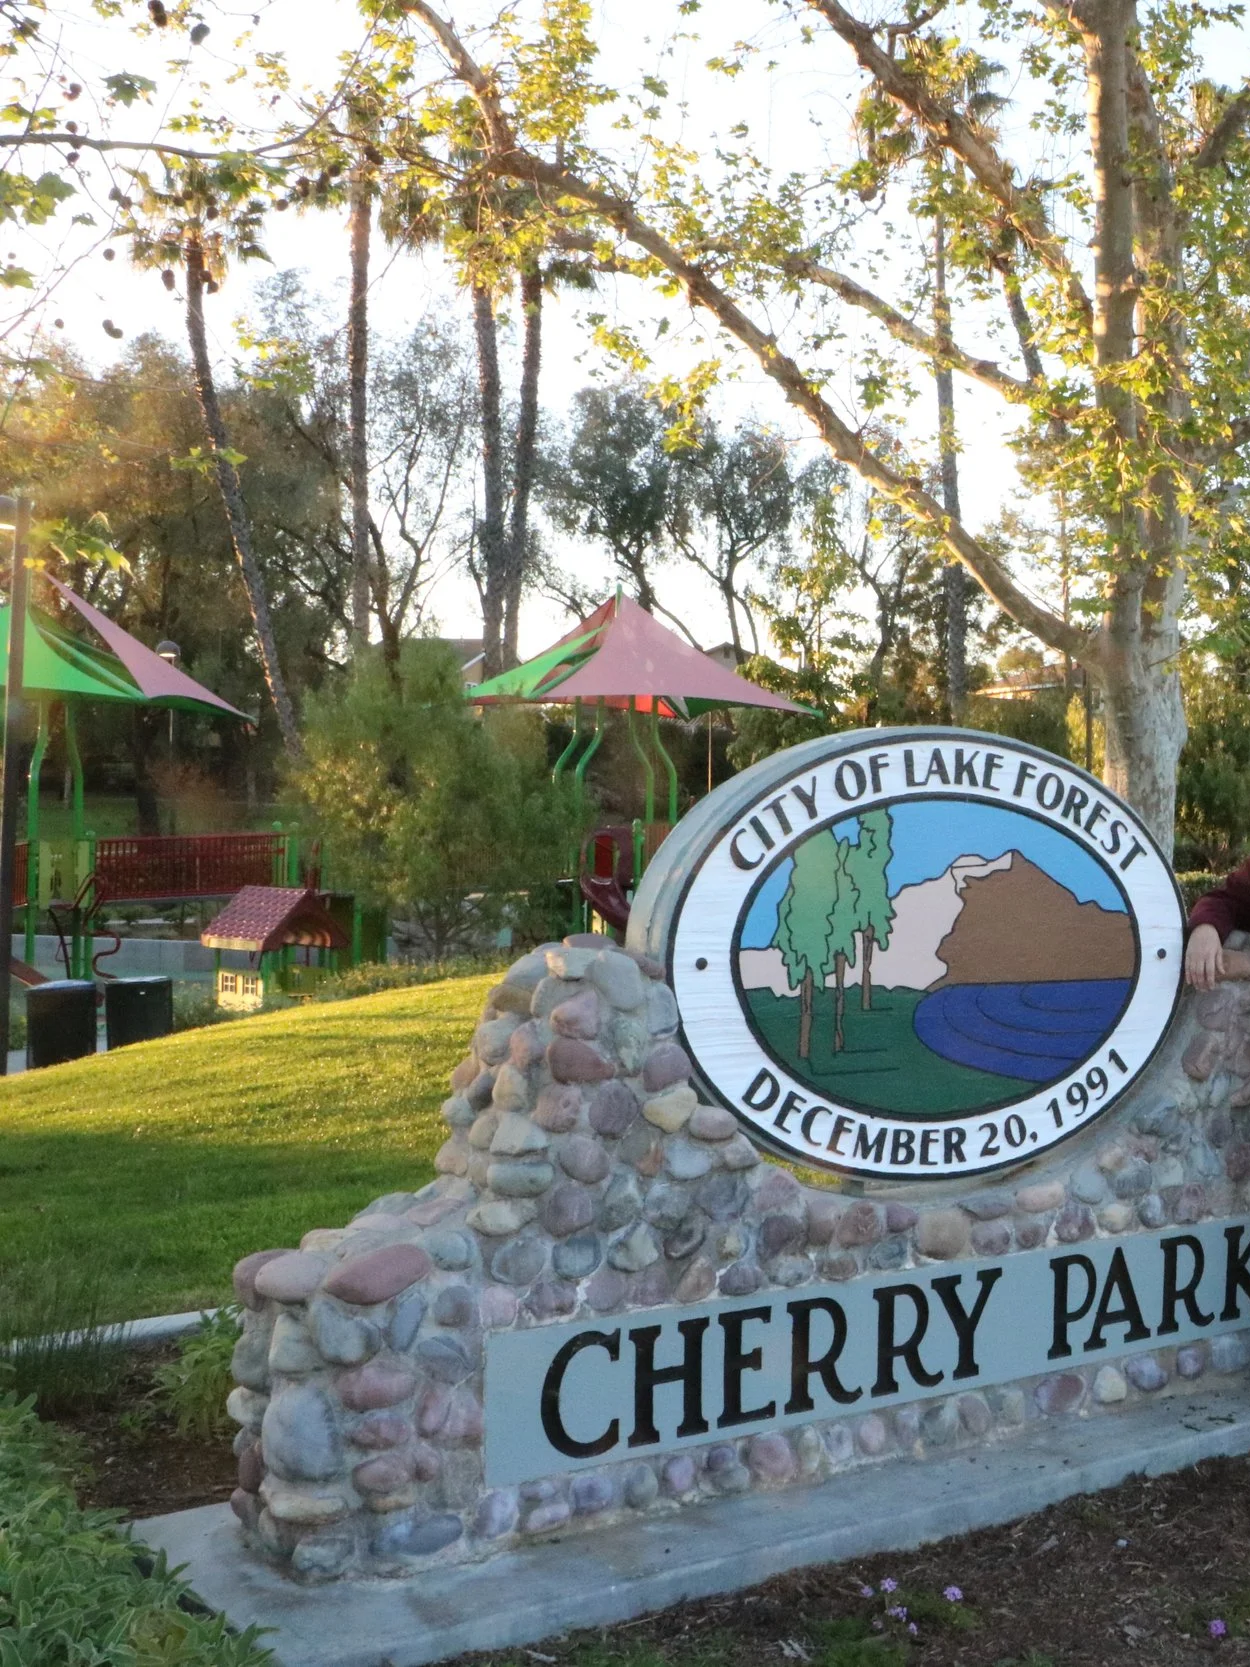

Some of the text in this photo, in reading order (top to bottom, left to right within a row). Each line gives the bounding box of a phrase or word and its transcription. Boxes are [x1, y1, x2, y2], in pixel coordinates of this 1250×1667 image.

[729, 747, 1148, 872] CITY OF LAKE FOREST
[741, 1048, 1129, 1166] DECEMBER 20, 1991
[539, 1267, 1002, 1459] CHERRY
